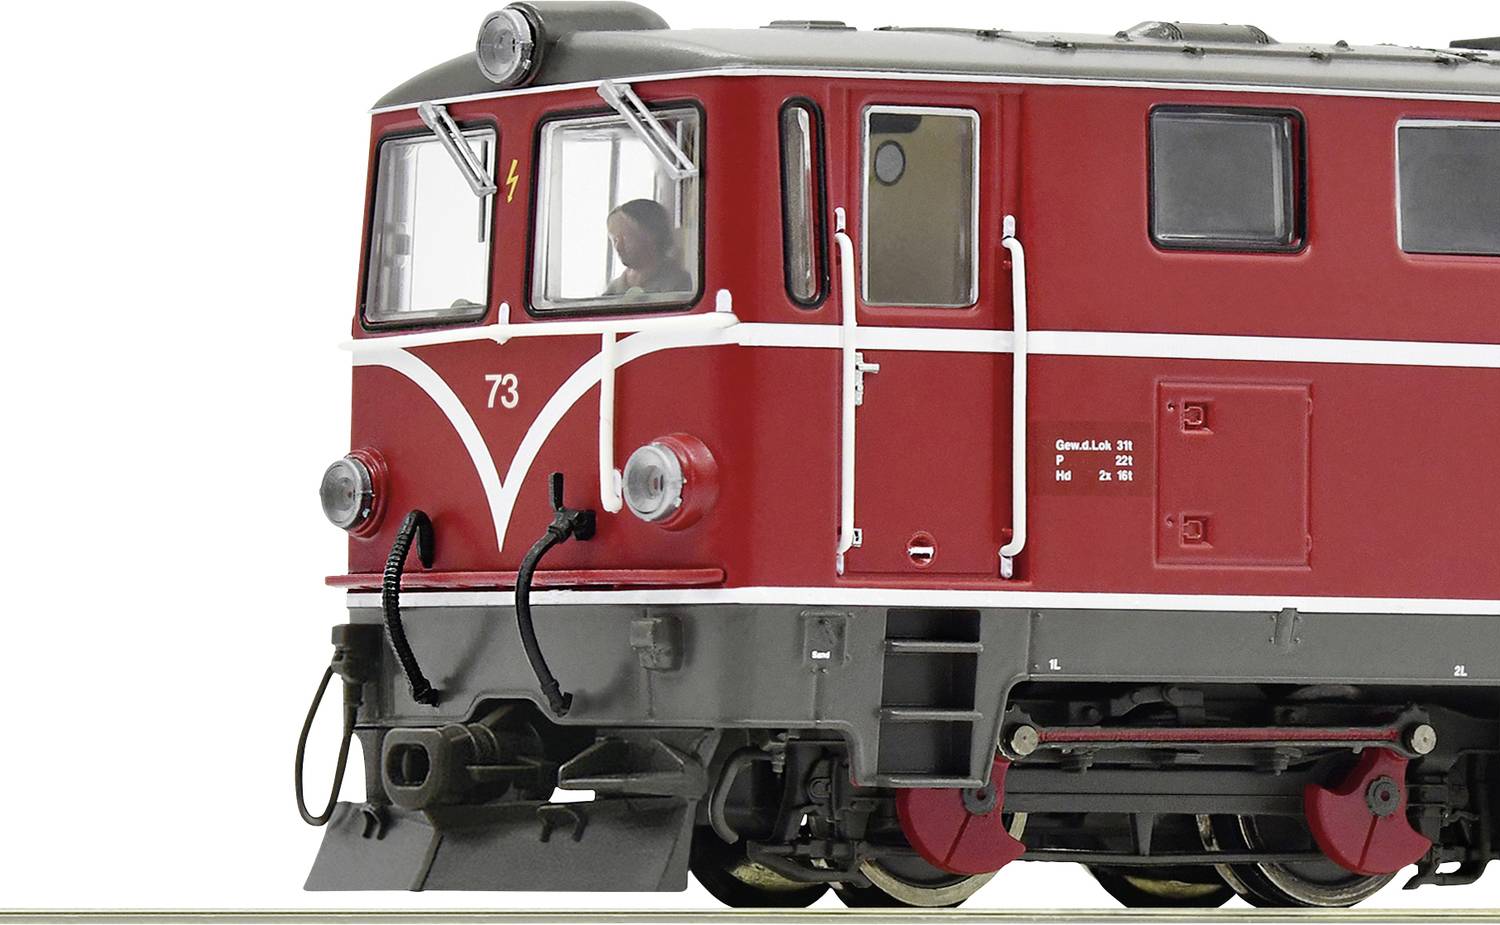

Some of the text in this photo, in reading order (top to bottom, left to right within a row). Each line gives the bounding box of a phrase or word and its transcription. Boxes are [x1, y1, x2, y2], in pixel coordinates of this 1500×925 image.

[484, 373, 519, 409] 73
[1055, 439, 1133, 451] Gew.d.Lok 31t
[1055, 454, 1133, 466] P 22t
[1055, 470, 1133, 481] Hd 2x 16t
[1048, 659, 1061, 671] 1L
[1454, 665, 1468, 677] 2L
